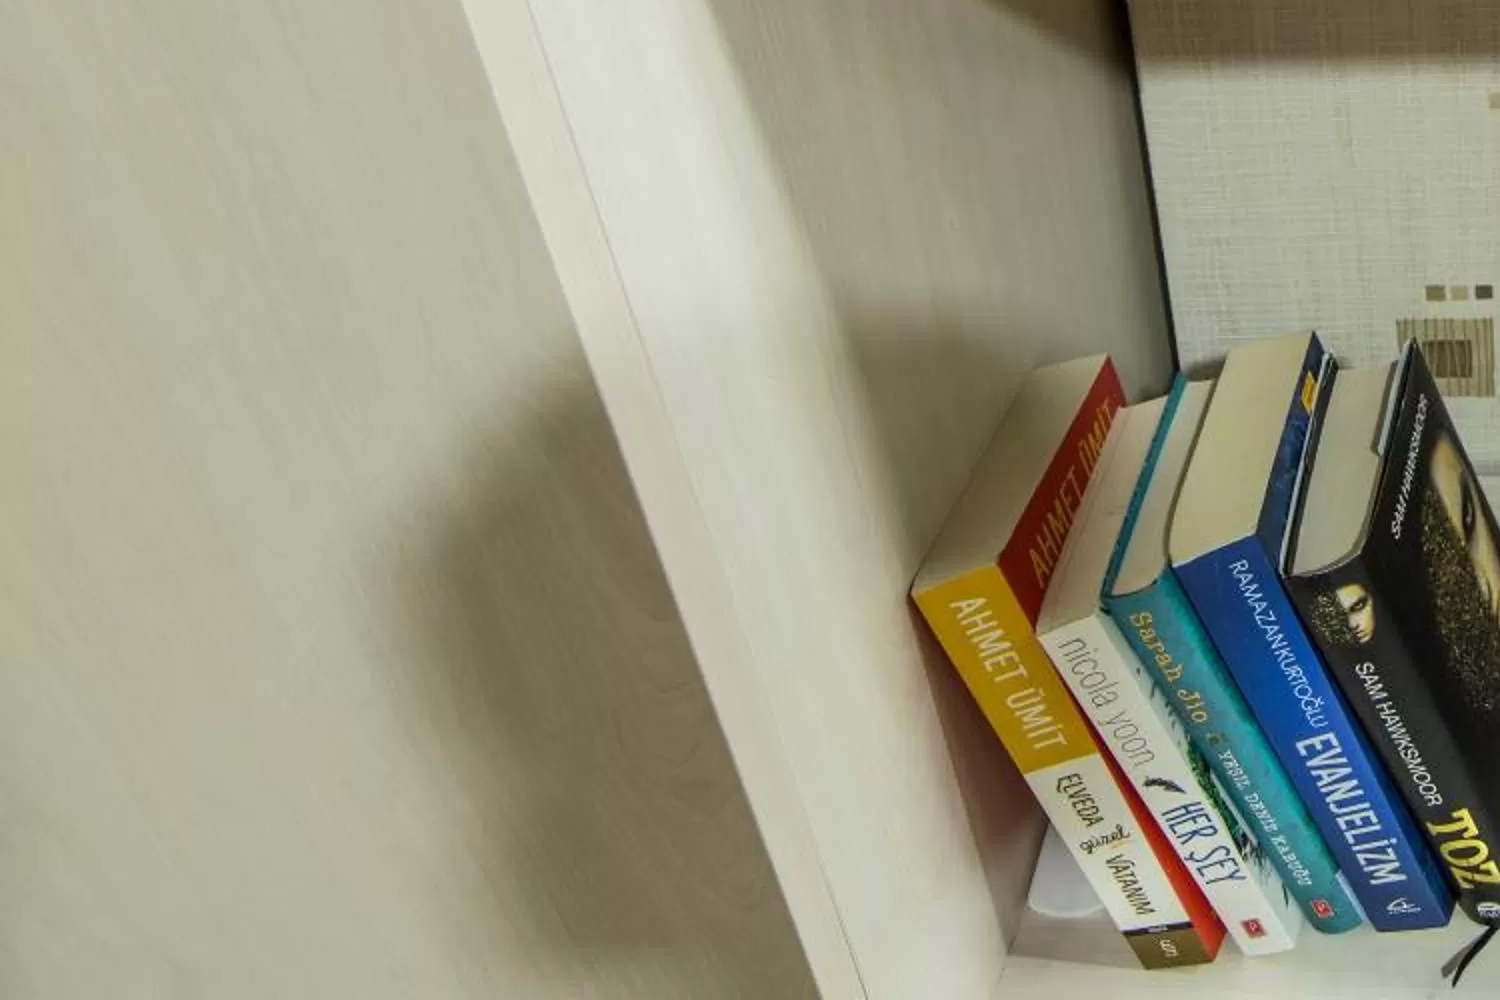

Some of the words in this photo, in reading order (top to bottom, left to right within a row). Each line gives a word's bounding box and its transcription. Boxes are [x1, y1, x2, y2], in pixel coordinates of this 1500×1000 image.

[1029, 465, 1084, 589] AHMET
[1229, 559, 1288, 650] RAMAZAN
[950, 597, 1028, 683] AHMET
[1007, 687, 1068, 749] ÜMİT
[1058, 637, 1119, 708] nicola
[1098, 710, 1155, 768] yoon
[1130, 612, 1184, 683] Sarah
[1177, 688, 1208, 723] Jio
[1355, 662, 1388, 701] SAM
[1376, 701, 1443, 807] HAWKSMOOR
[1056, 773, 1105, 828] ELVEDA
[1080, 823, 1131, 855] güzel
[1161, 801, 1218, 845] HER
[1296, 732, 1408, 885] EVANJELİZM
[1104, 853, 1156, 915] VATANIM
[1184, 846, 1247, 885] ŞEY
